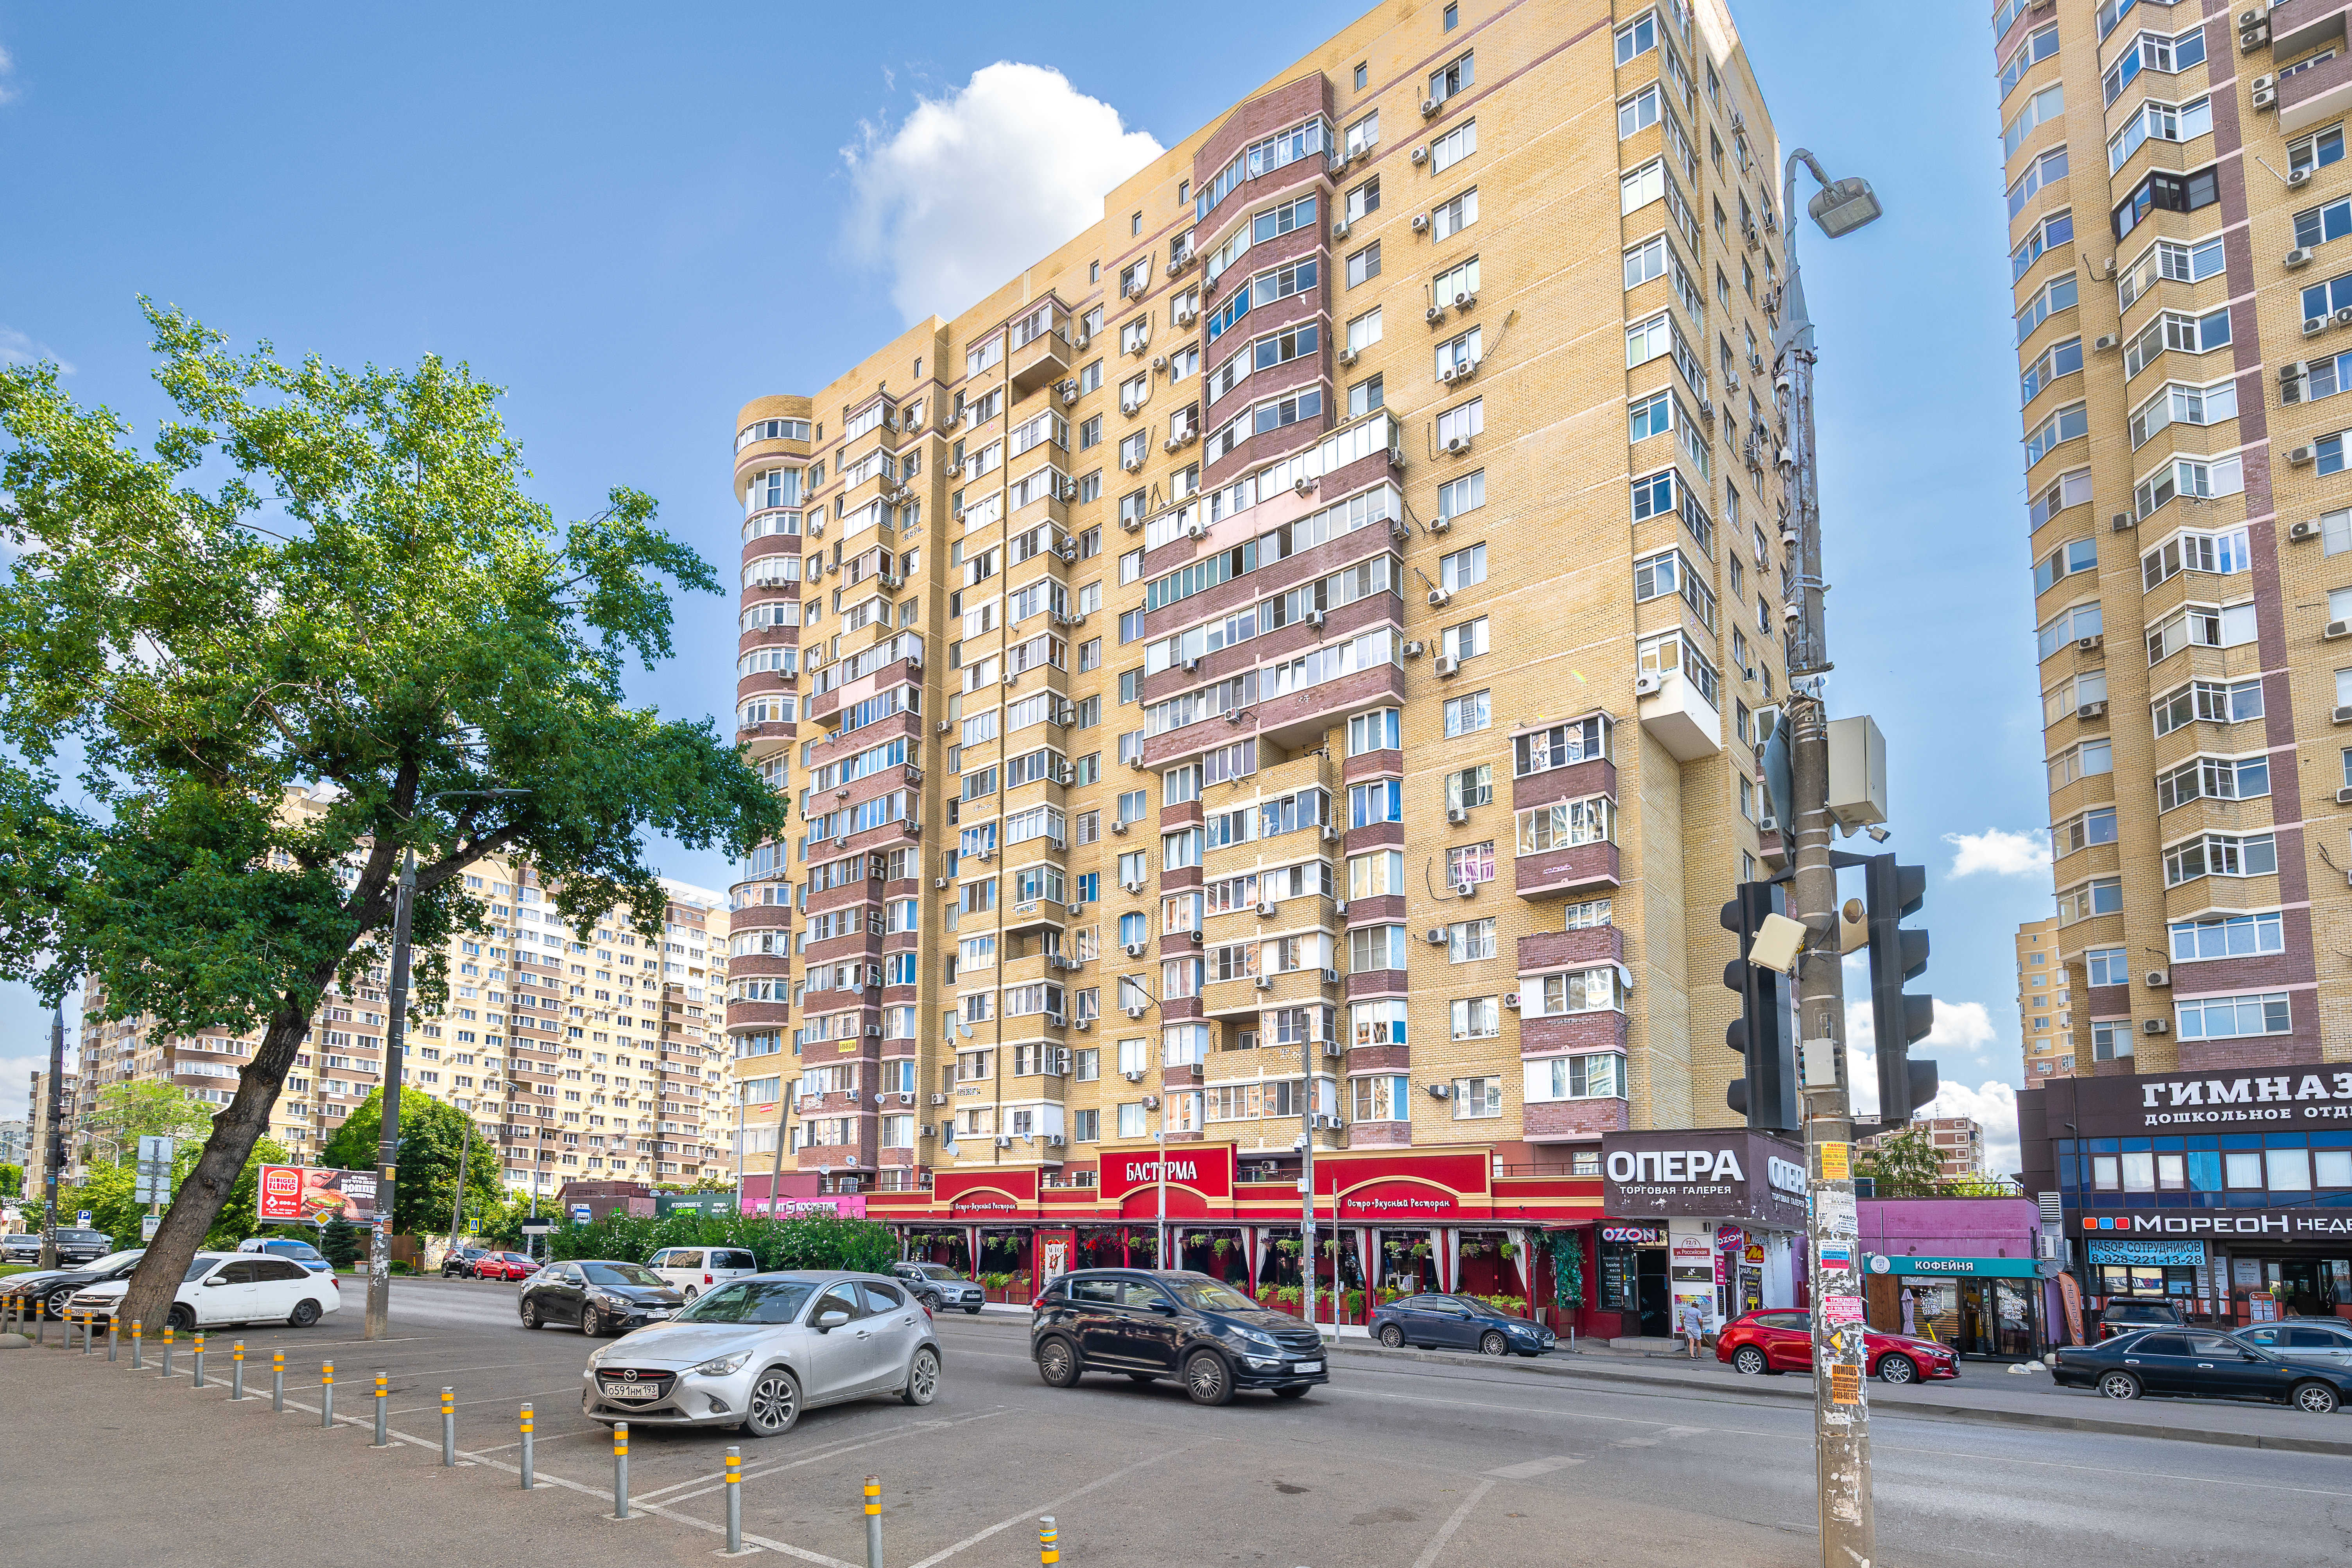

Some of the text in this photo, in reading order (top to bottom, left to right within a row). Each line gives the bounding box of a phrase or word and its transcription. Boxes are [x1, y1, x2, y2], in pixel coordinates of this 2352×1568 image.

[2145, 1106, 2352, 1126] ДОШКОЛЬНОЕ ОТД
[1607, 1150, 1745, 1182] ОПЕРА
[1768, 1156, 1805, 1195] ОПЕР
[341, 1183, 376, 1194] ВОППЕ
[1619, 1186, 1731, 1194] ТОРГОВАЯ ГАЛЕРЕЯ
[1411, 1198, 1450, 1212] Ресторан
[1771, 1192, 1804, 1208] ТОРГОВАЯ ГАЛЕРЕЯ
[992, 1202, 1016, 1213] Ресторан
[1603, 1227, 1657, 1242] OZON
[1718, 1233, 1742, 1244] OZON
[2090, 1241, 2201, 1254] НАБОР СОТРУДНИКОВ
[2092, 1254, 2203, 1264] 8-928-221-13-28
[1915, 1260, 1974, 1271] КОФЕЙНЯ
[1833, 1365, 1857, 1377] ПОМОЩЬ
